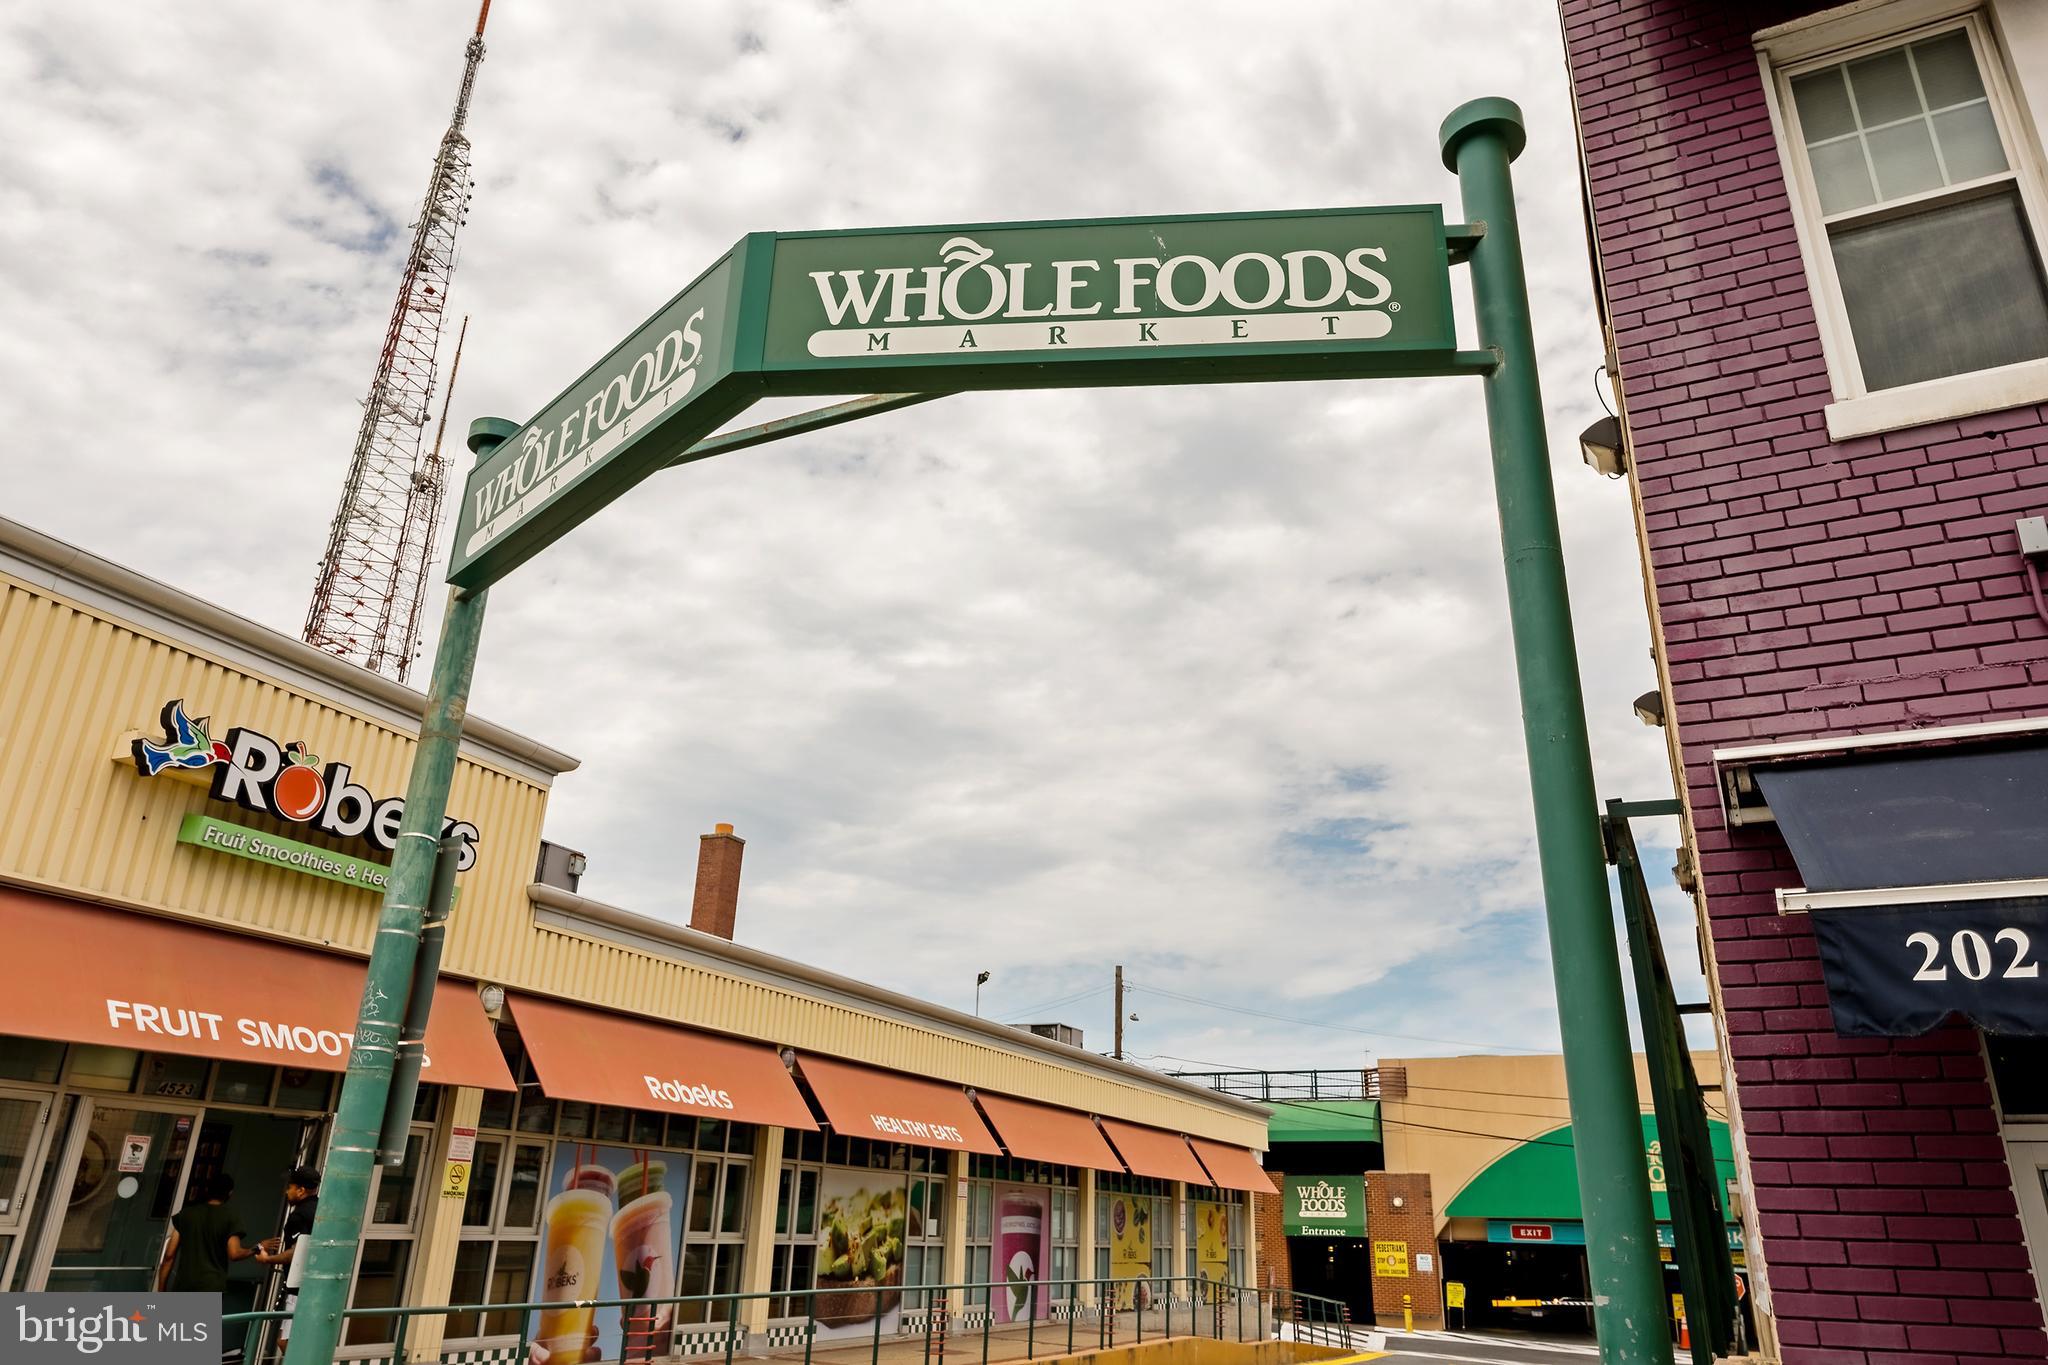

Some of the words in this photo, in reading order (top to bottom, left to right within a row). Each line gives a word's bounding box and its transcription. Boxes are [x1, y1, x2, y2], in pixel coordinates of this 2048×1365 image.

[809, 237, 1103, 325] WHOLE
[1114, 247, 1393, 314] FOODS
[866, 315, 1340, 352] MARKET
[475, 409, 580, 529] WHOLE
[577, 307, 704, 450] FOODS
[484, 387, 672, 541] MARKET
[203, 825, 247, 851] Fruit
[249, 836, 342, 876] Smoothies
[345, 862, 358, 879] &
[1905, 927, 2039, 981] 202
[106, 999, 223, 1041] FRUIT
[157, 1081, 196, 1097] 4523
[643, 1075, 734, 1110] Robeks
[870, 1114, 931, 1139] HEALTHY
[932, 1124, 963, 1143] EATS
[1296, 1180, 1346, 1199] WHOLE
[1300, 1199, 1345, 1212] FOODS
[1301, 1225, 1346, 1236] Entrance
[1519, 1228, 1543, 1237] EXIT
[1376, 1244, 1405, 1253] PEDESTRIANS
